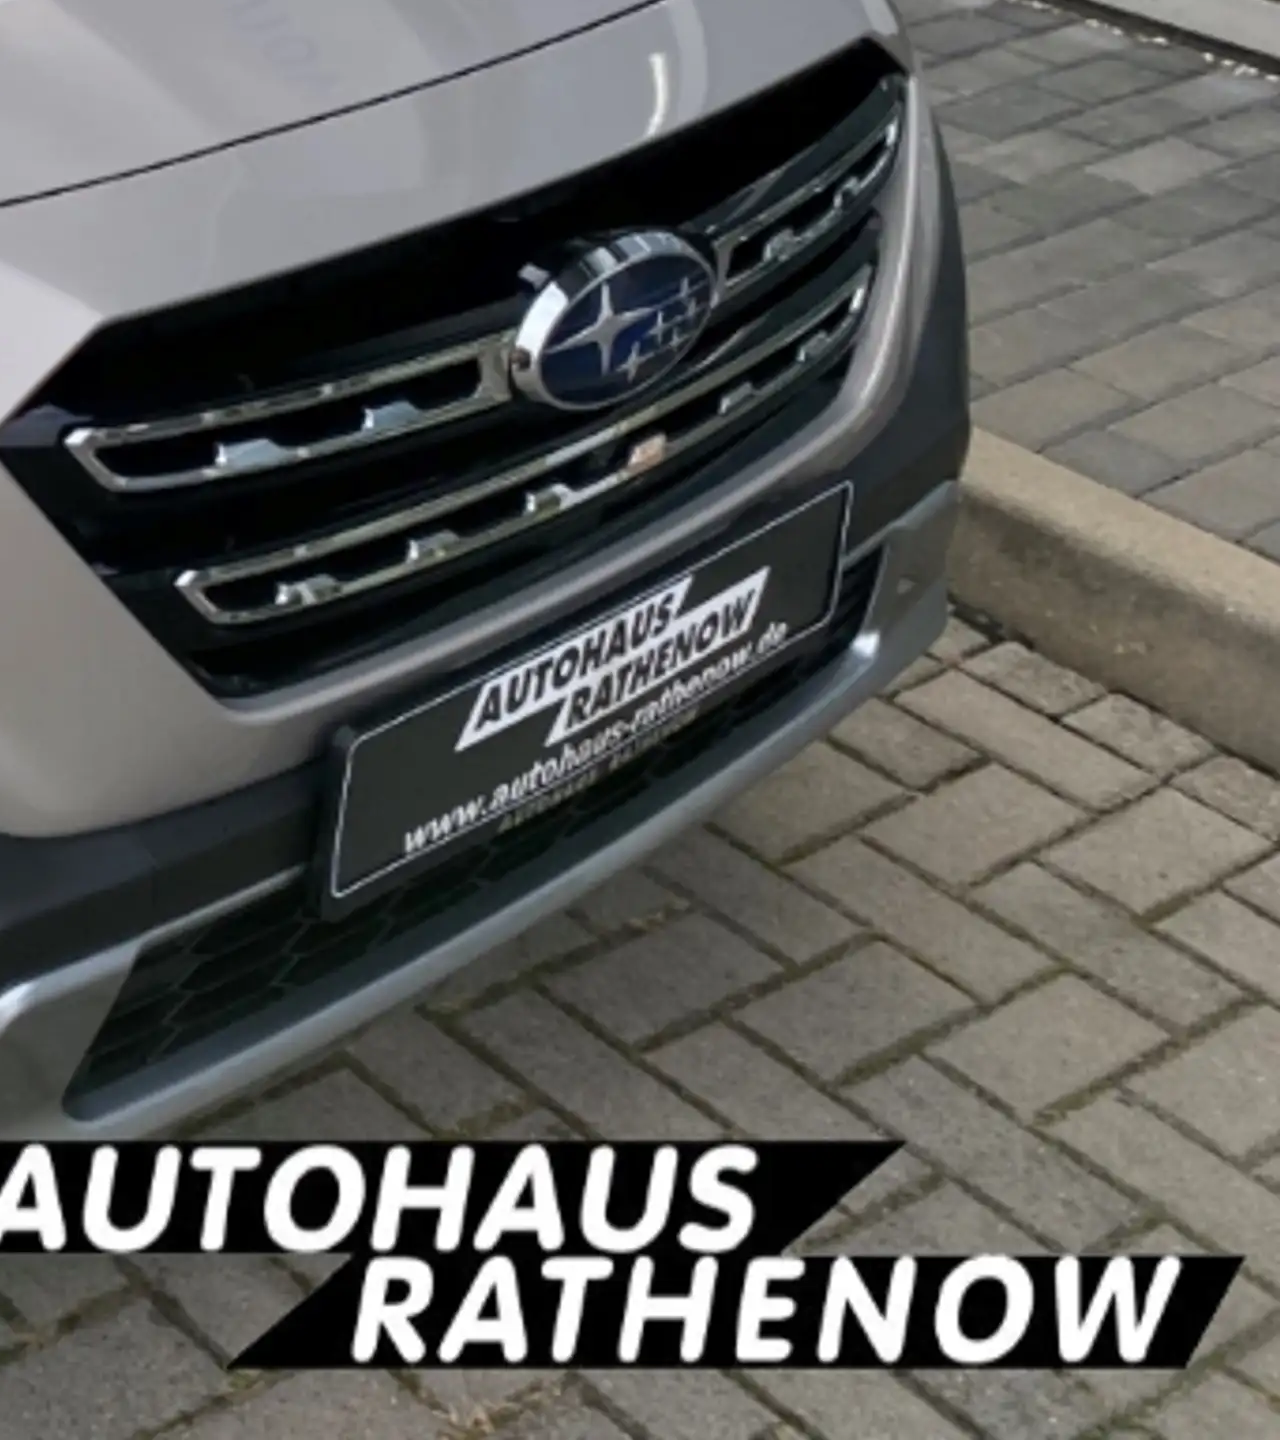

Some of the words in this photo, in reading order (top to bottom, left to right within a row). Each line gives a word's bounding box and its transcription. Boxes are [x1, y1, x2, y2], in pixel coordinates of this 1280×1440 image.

[476, 589, 681, 732] AUTOHAUS
[564, 589, 759, 728] RATHENOW
[402, 620, 790, 857] www.autohaus-rathenow.de
